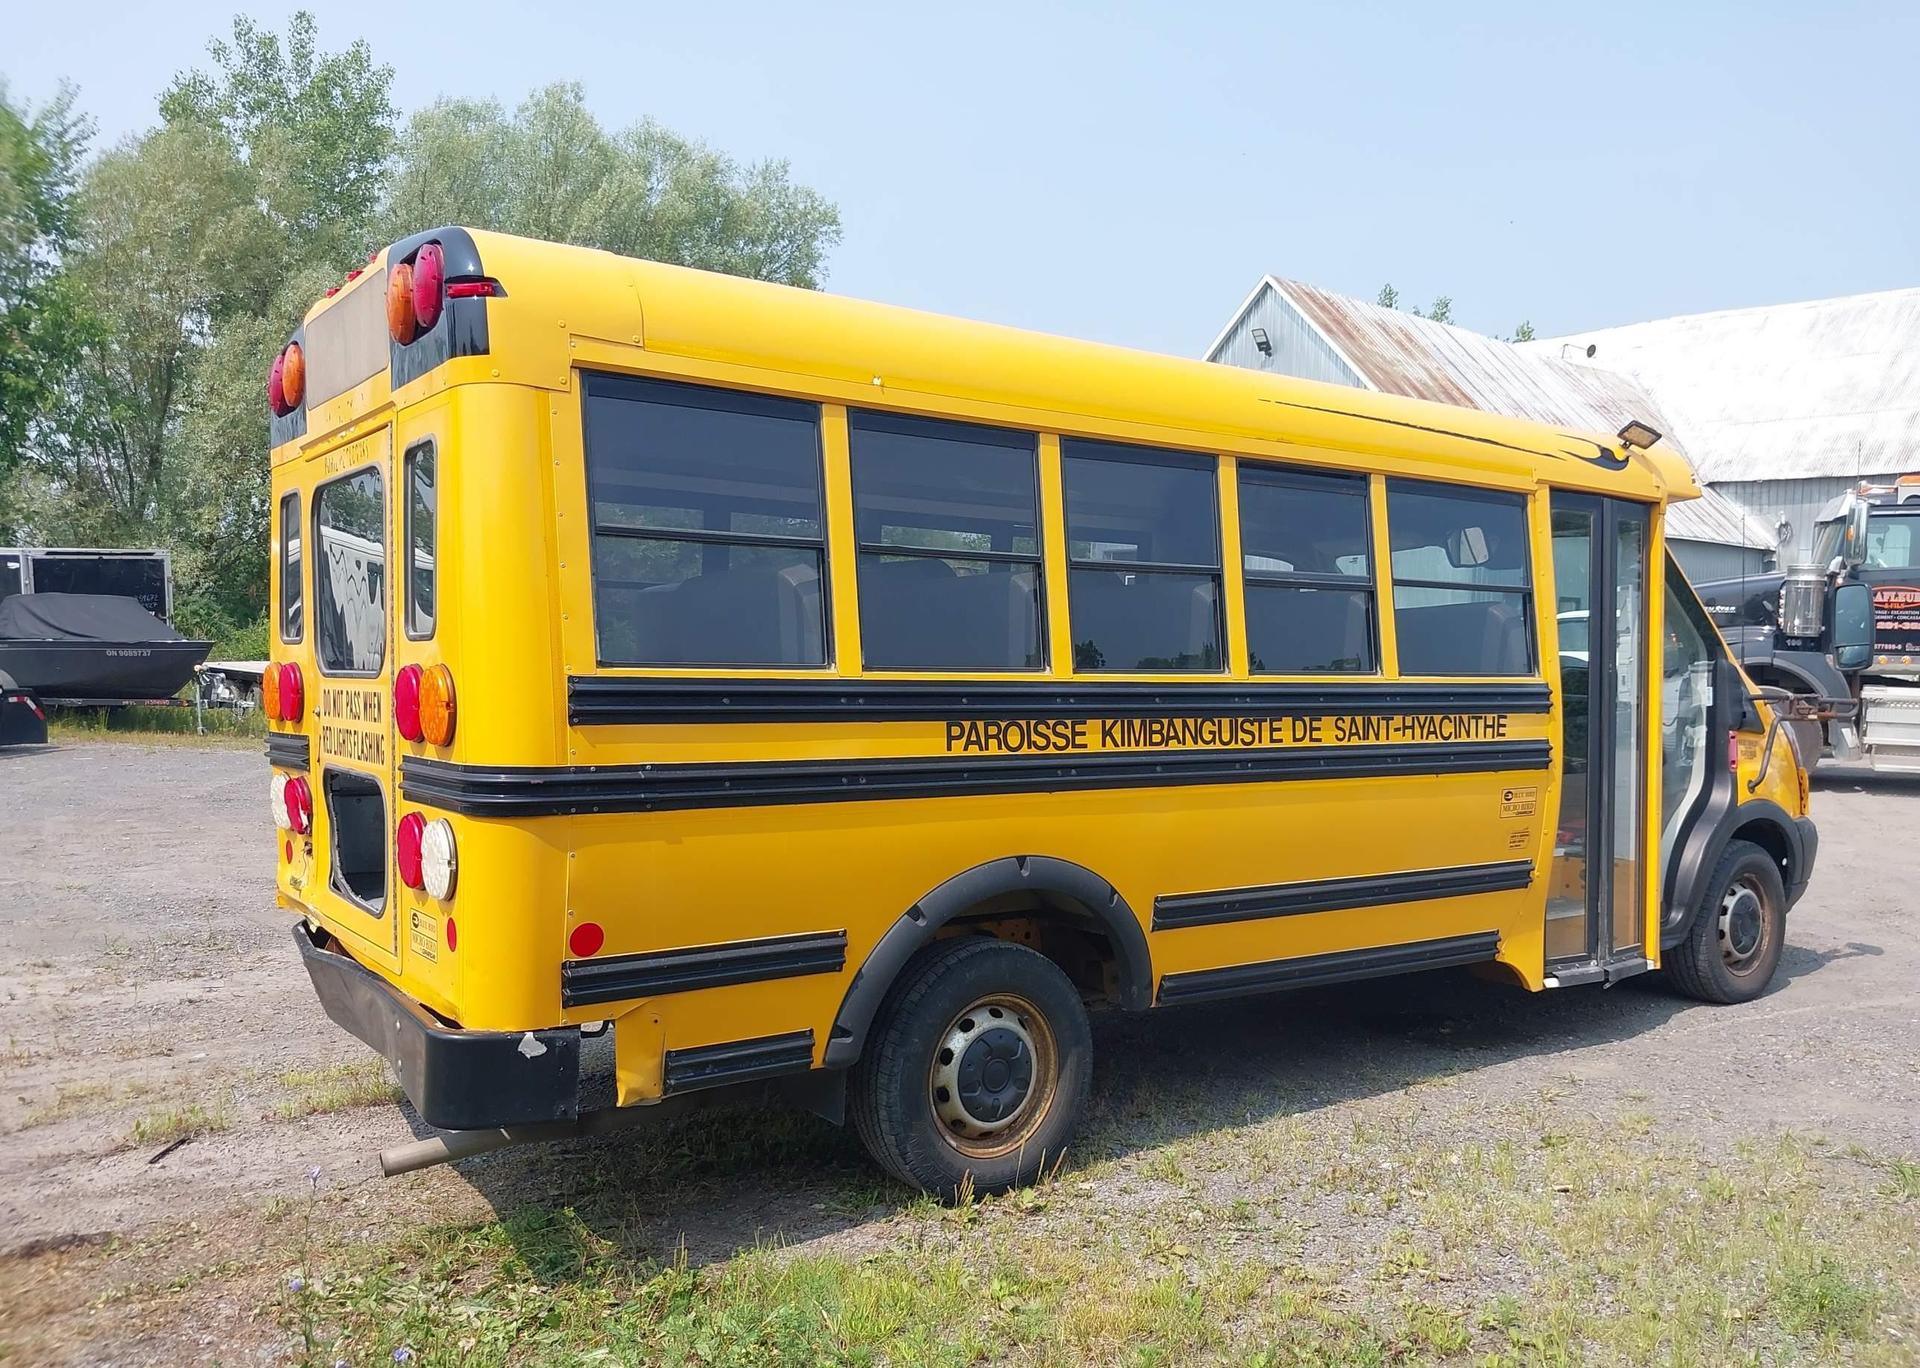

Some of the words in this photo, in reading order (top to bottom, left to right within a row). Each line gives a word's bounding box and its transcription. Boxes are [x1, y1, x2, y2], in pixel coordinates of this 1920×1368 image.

[323, 689, 332, 717] DO
[333, 689, 343, 718] NOT
[346, 690, 361, 720] PASS
[363, 691, 382, 723] WHEN
[323, 725, 333, 754] RED
[333, 727, 353, 759] LIGHTS
[353, 730, 385, 766] FLASHING
[946, 719, 1088, 753] PAROISSE
[1101, 717, 1284, 748] KIMBANGUISTE
[1292, 716, 1323, 743] DE
[1334, 714, 1508, 743] SAINT-HYACINTHE
